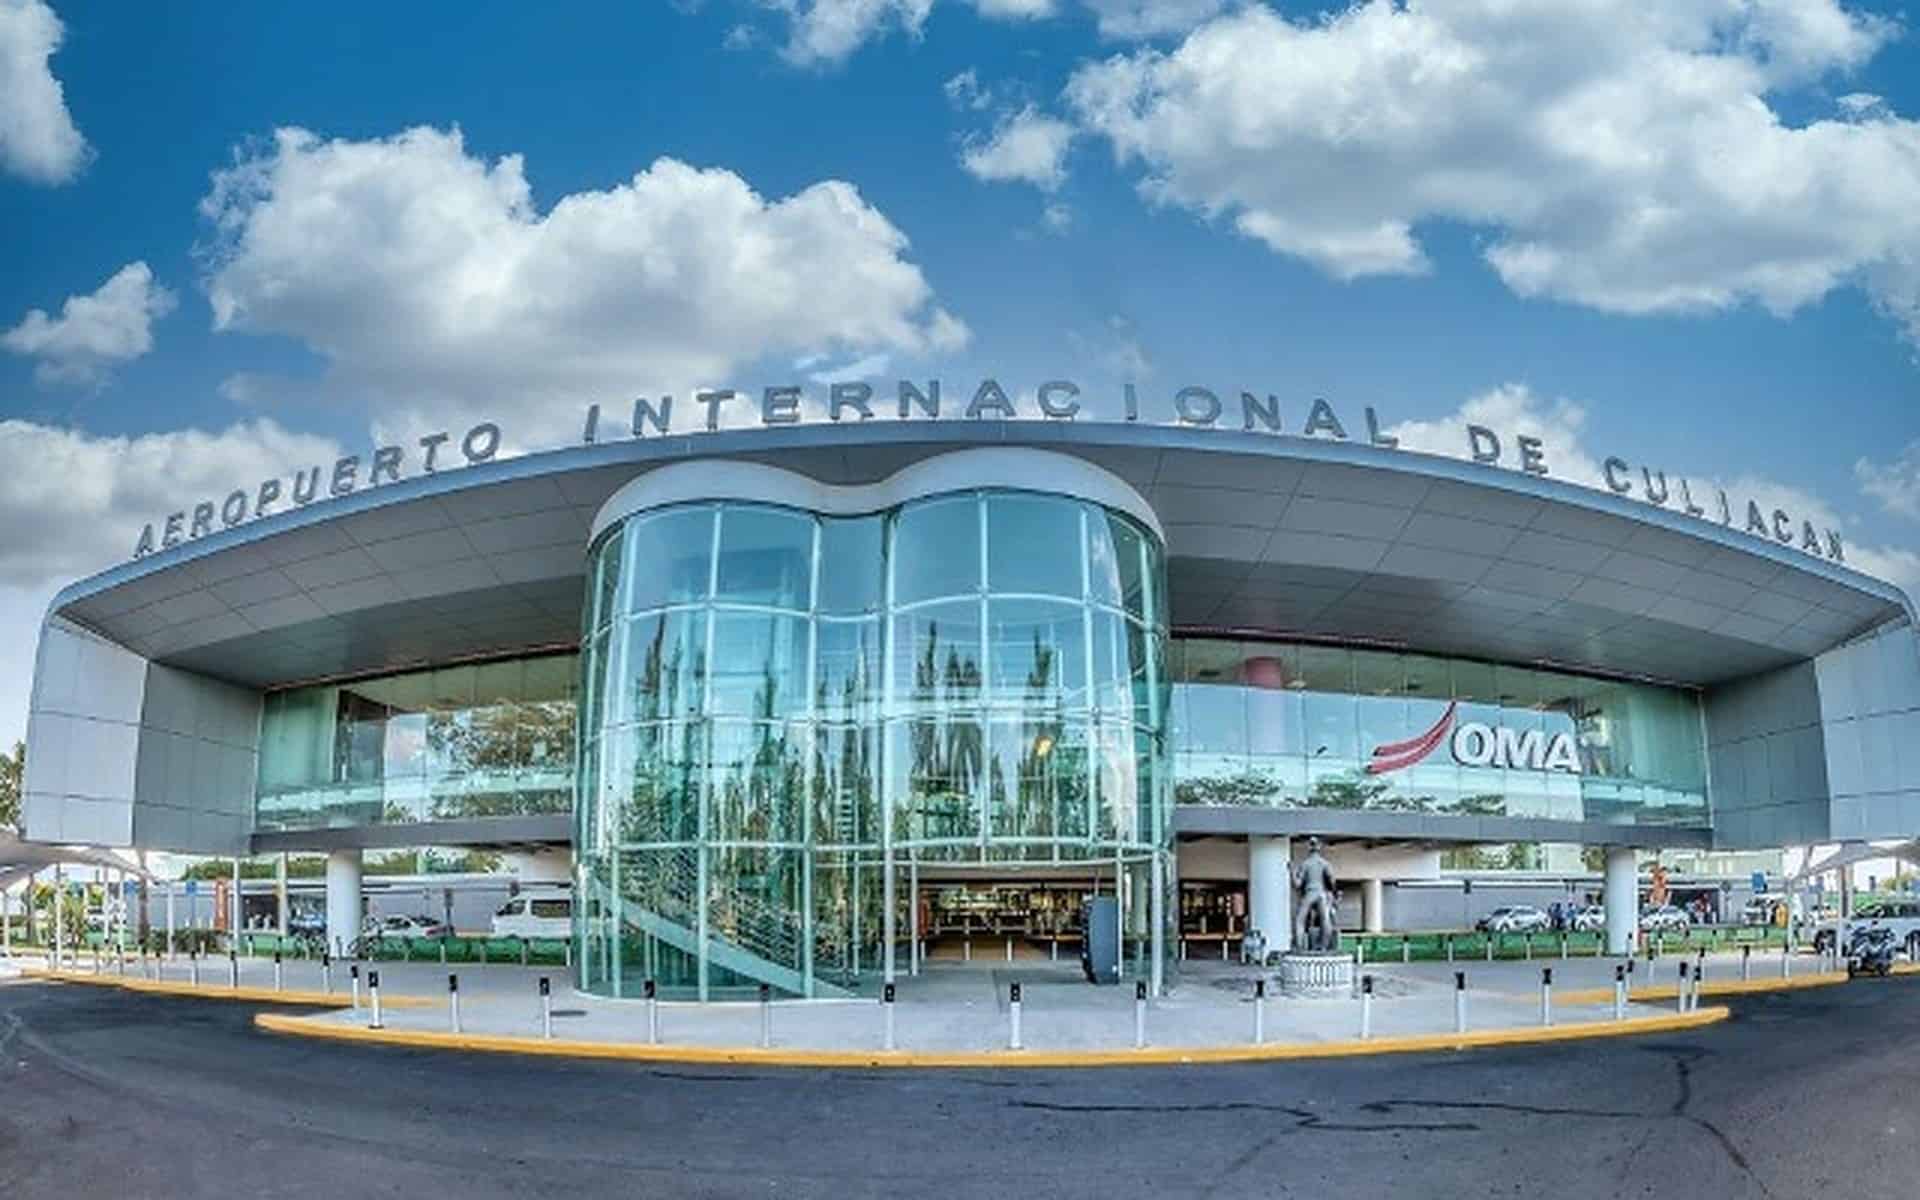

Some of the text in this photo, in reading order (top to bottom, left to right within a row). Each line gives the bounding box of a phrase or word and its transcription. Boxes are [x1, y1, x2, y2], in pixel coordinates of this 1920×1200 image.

[133, 379, 1845, 561] AEROPUERTO INTERNACIONAL DE CULIACAN
[1451, 722, 1584, 774] OMA
